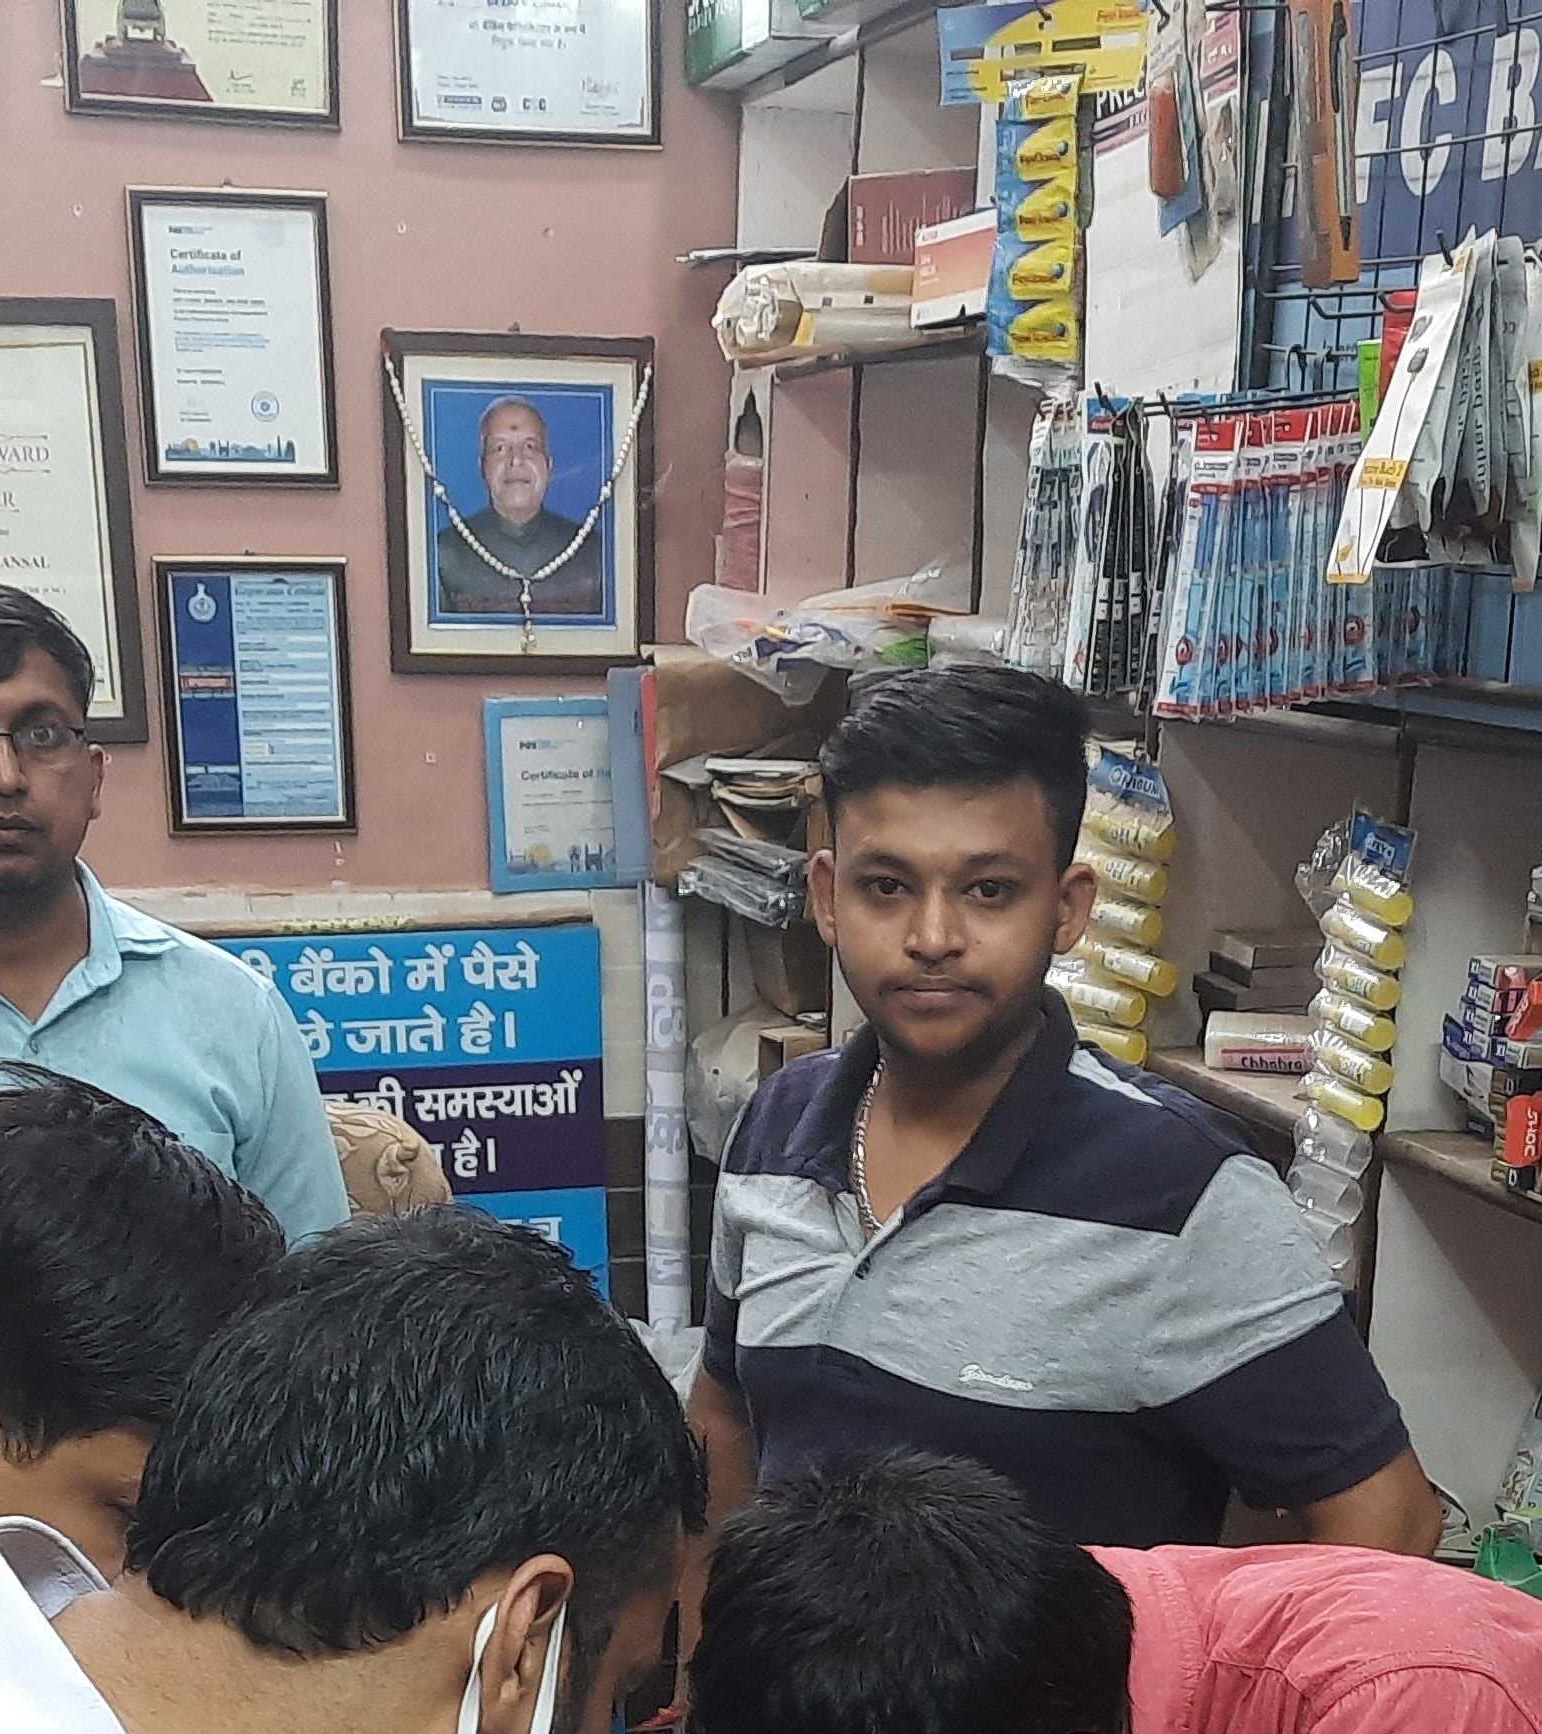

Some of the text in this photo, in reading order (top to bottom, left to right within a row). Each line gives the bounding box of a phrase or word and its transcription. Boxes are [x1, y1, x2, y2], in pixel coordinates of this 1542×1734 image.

[170, 249, 241, 261] Certificate of
[521, 769, 594, 781] Certificate of
[287, 945, 393, 997] बैंको
[404, 942, 456, 994] में
[462, 939, 540, 991] पैसे
[342, 1003, 447, 1056] जाते
[413, 1069, 584, 1122] समस्याओं
